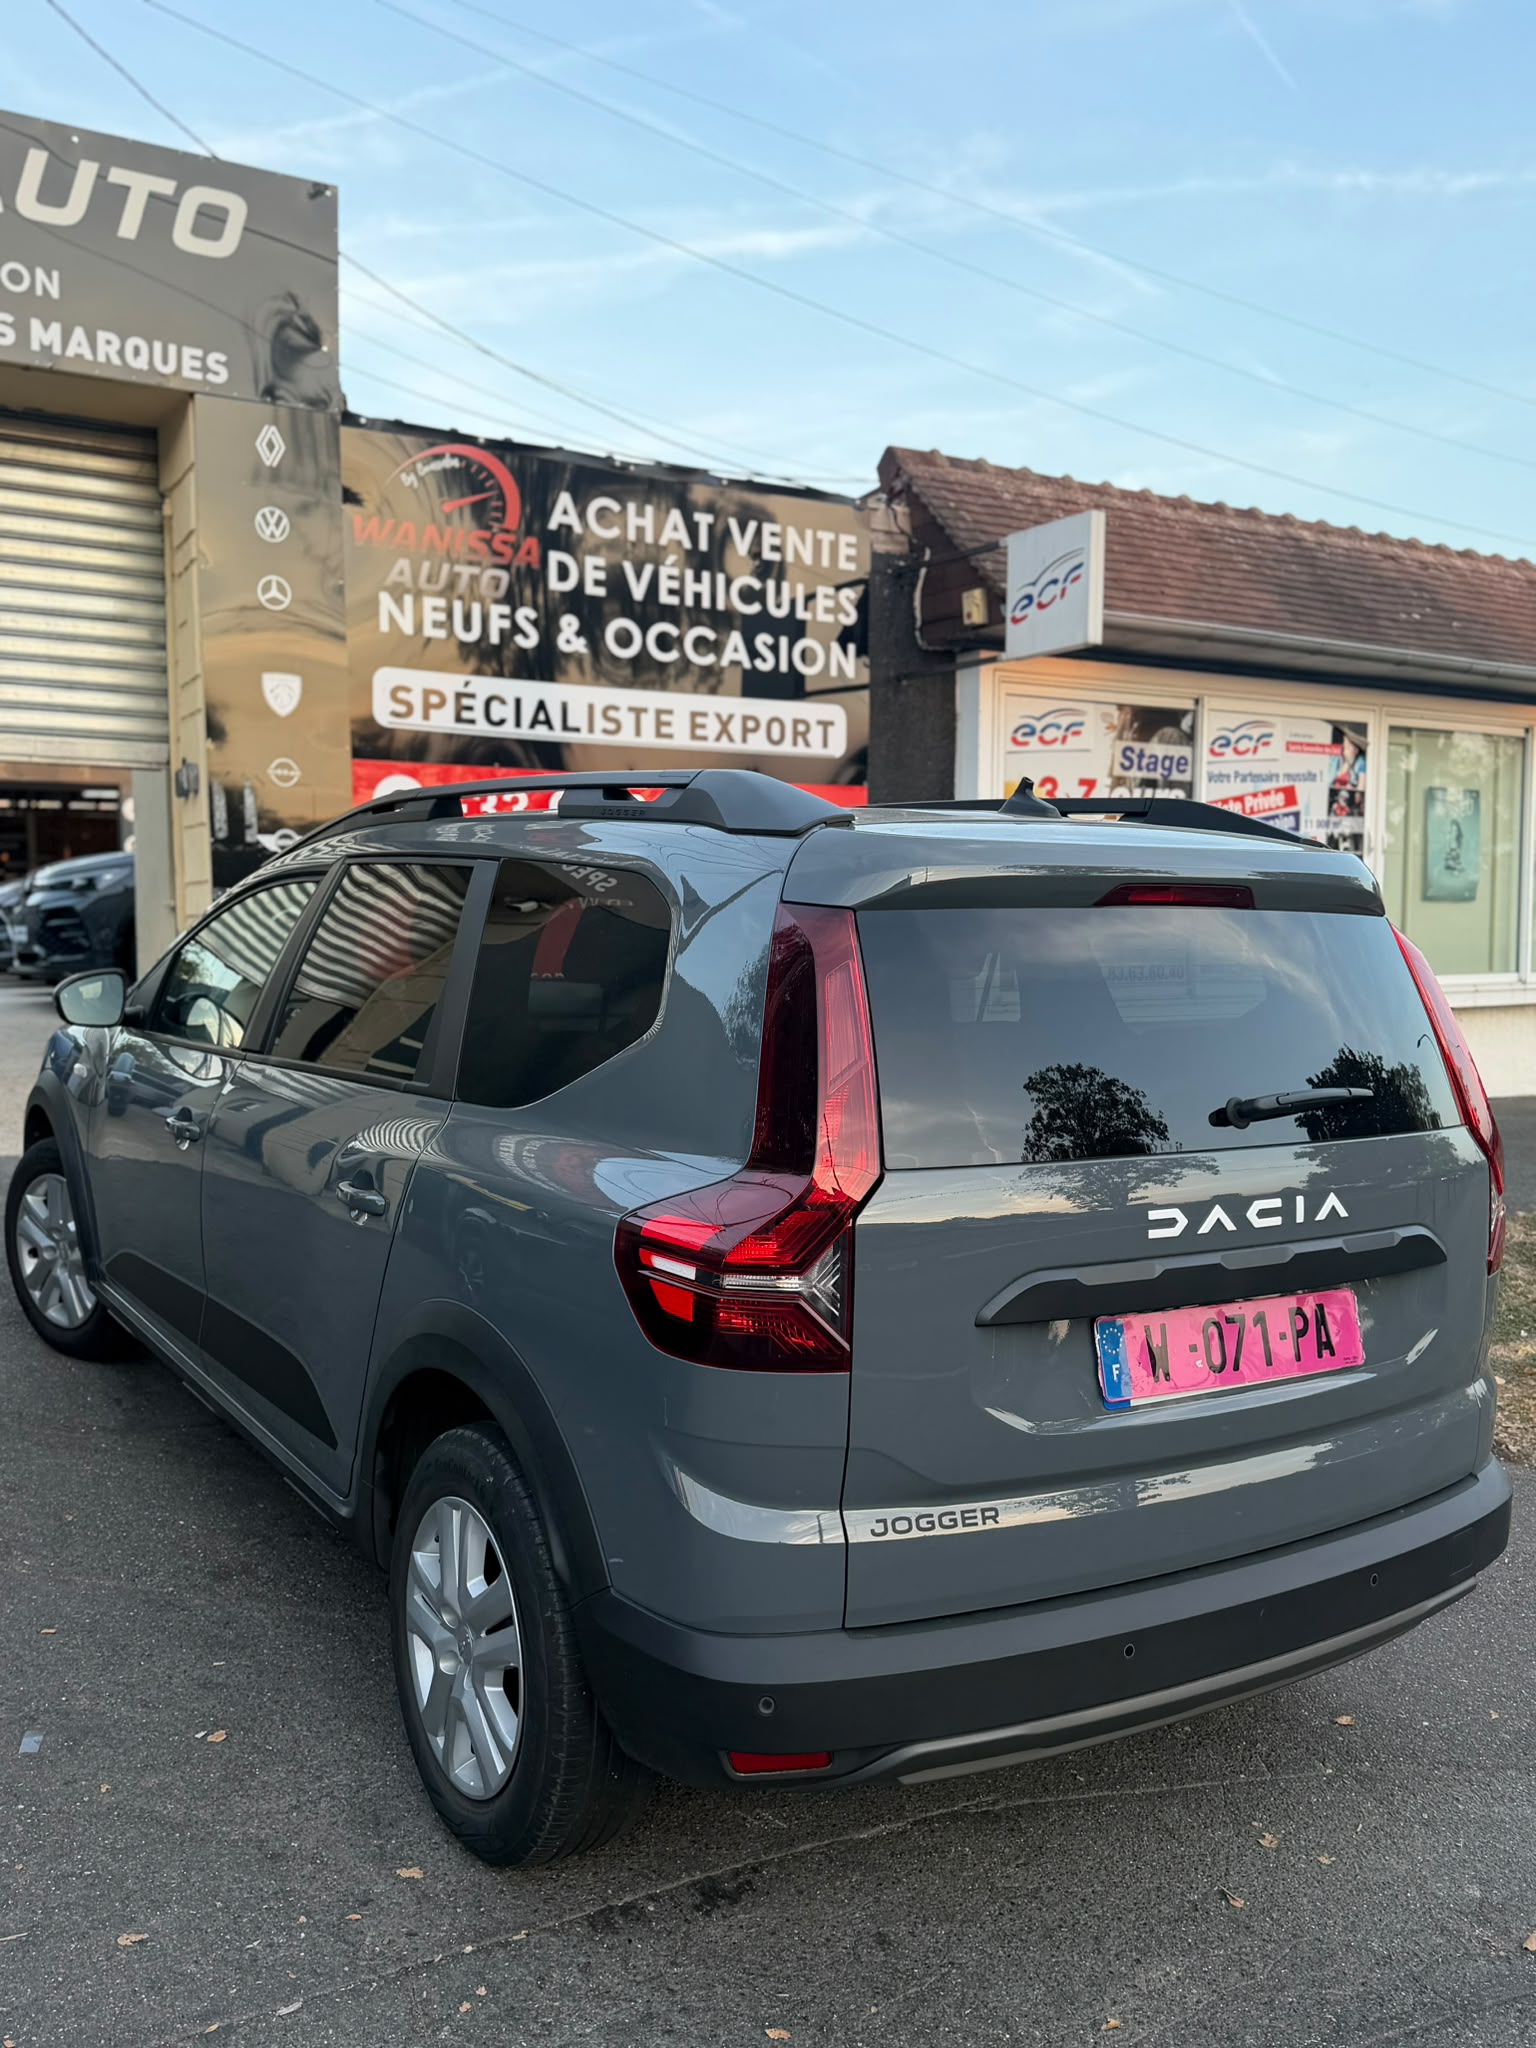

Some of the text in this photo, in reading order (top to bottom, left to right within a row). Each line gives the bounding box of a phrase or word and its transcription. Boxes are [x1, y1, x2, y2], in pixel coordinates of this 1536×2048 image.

[0, 148, 248, 259] UTO
[30, 317, 229, 384] MARQUES
[352, 513, 541, 569] WANISSA
[547, 491, 858, 571] ACHAT VENTE
[384, 557, 511, 599] AUTO
[548, 551, 858, 627] DE VÉHICULES
[378, 591, 857, 680] NEUFS & OCCASION
[388, 682, 835, 750] SPÉCIALISTE EXPORT
[1120, 746, 1189, 779] Stage
[1207, 770, 1231, 784] Votre
[1234, 770, 1280, 784] Partenaire
[1147, 1192, 1349, 1240] DACIA
[870, 1507, 1000, 1538] JOGGER
